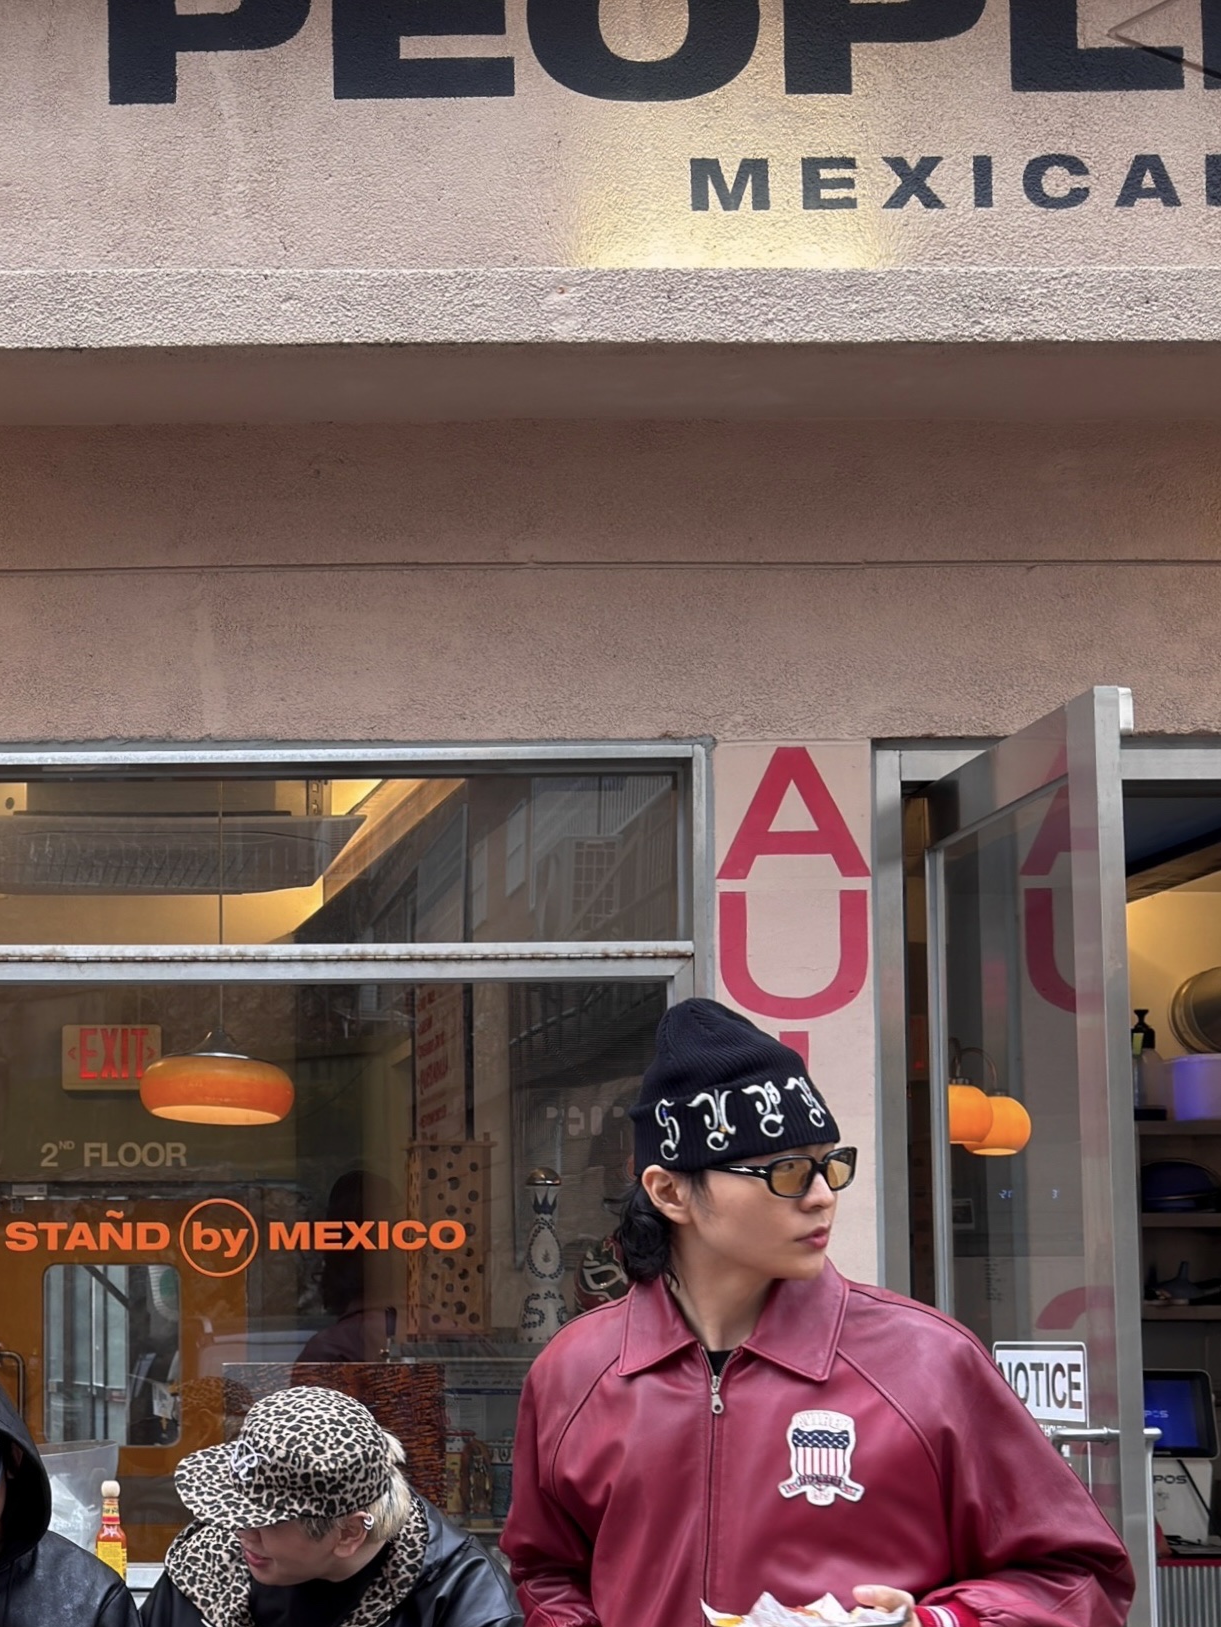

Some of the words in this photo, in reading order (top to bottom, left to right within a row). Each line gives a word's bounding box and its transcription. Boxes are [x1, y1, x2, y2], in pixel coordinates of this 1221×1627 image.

[108, 0, 1221, 105] PEOPL
[689, 153, 1221, 212] MEXICA
[79, 1028, 149, 1079] EXIT
[83, 1142, 187, 1167] FLOOR
[4, 1210, 171, 1252] STAÑD
[192, 1221, 249, 1258] by
[269, 1220, 467, 1251] MEXICO
[1153, 1475, 1188, 1485] POS
